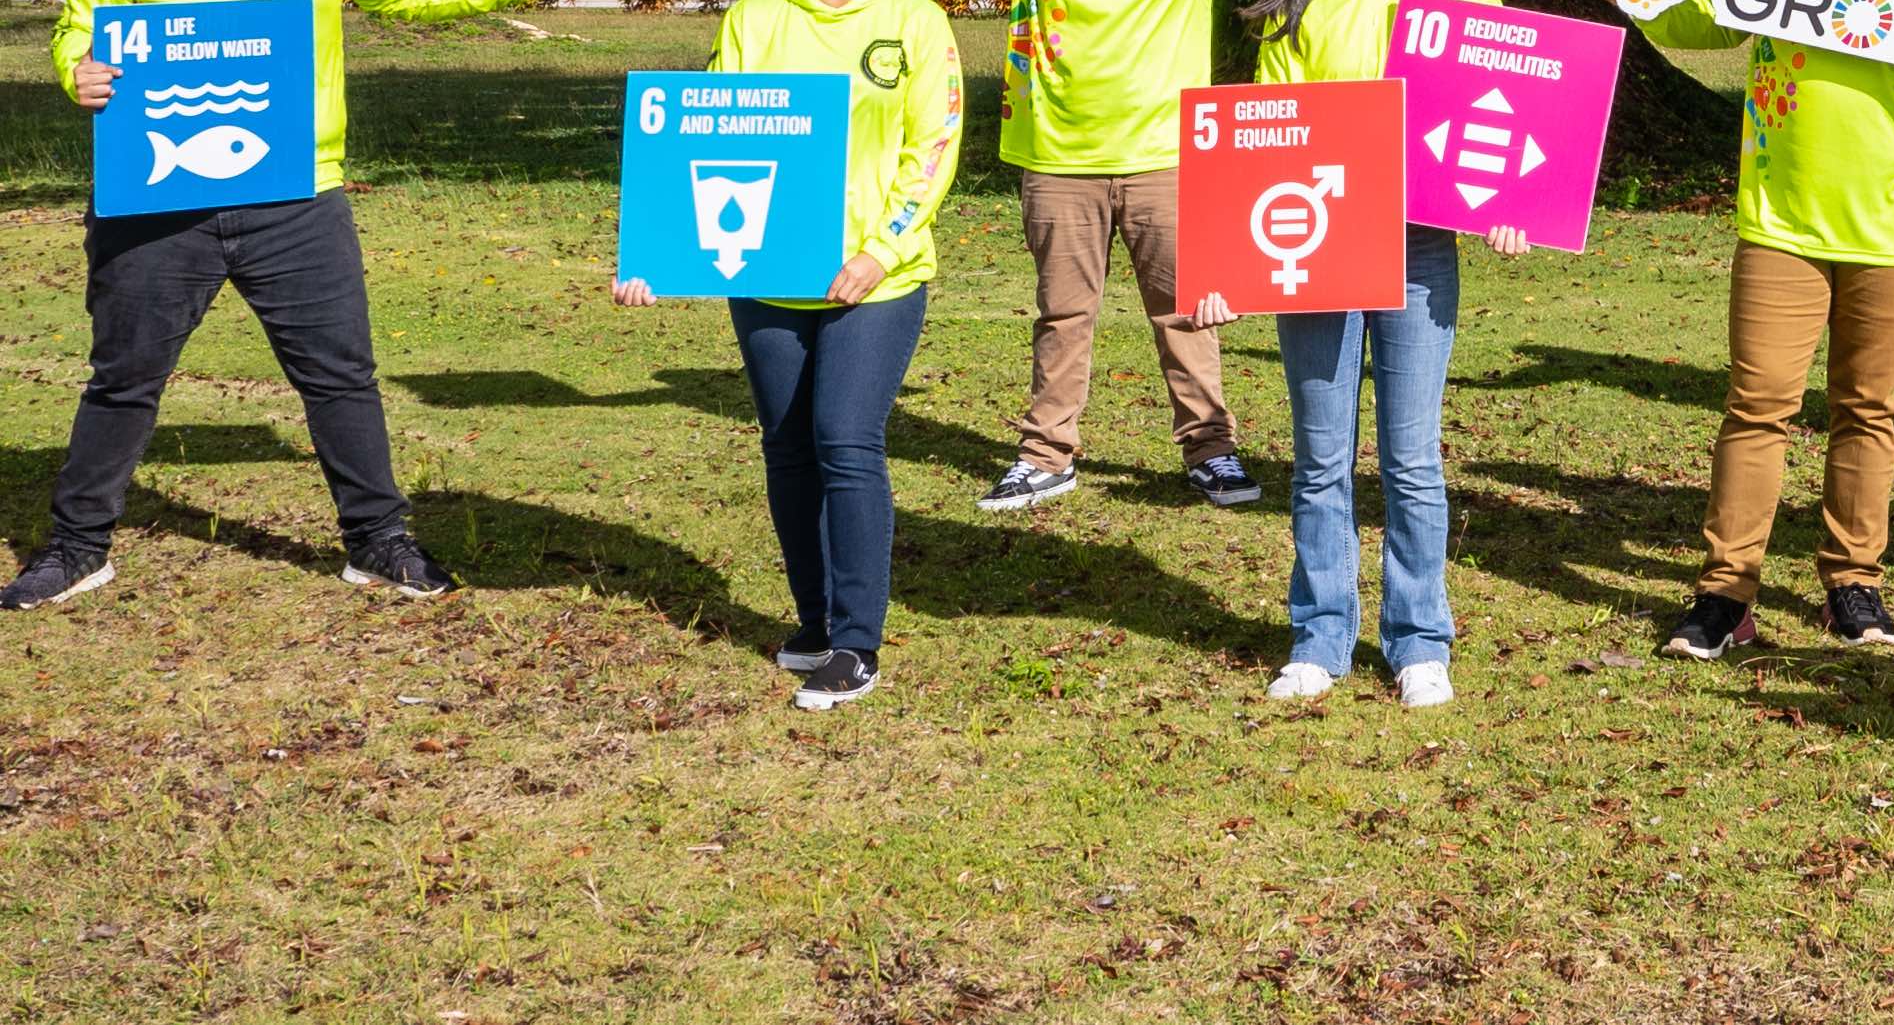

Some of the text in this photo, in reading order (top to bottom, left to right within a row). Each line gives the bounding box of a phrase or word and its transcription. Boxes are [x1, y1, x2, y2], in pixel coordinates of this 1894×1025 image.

[166, 18, 195, 36] LIFE
[1405, 9, 1449, 58] 10
[1464, 18, 1537, 47] REDUCED
[104, 20, 152, 64] 14
[166, 39, 271, 61] BELOW WATER
[1458, 44, 1562, 80] INEQUALITIES
[682, 88, 790, 107] CLEAN WATER
[1235, 100, 1297, 120] GENDER
[640, 88, 665, 134] 6
[680, 115, 811, 135] AND SANITATION
[1194, 103, 1218, 150] 5
[1235, 127, 1310, 150] EQUALITY
